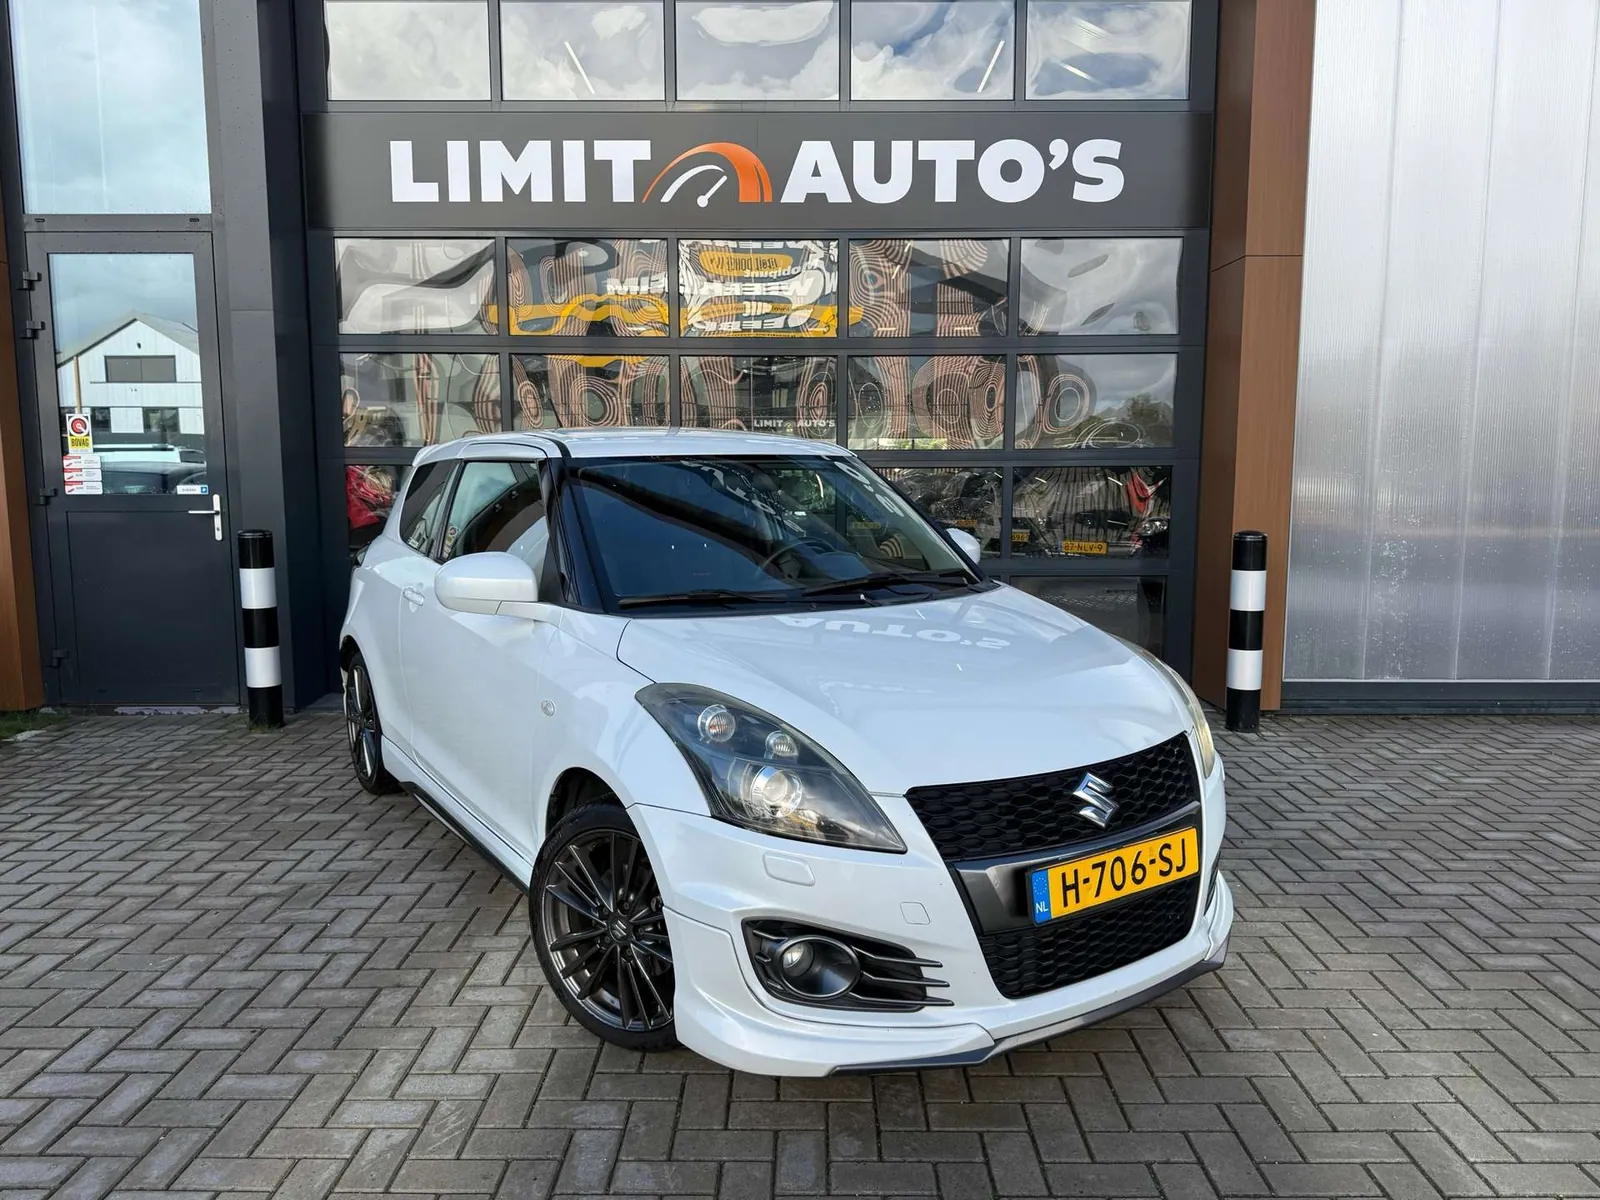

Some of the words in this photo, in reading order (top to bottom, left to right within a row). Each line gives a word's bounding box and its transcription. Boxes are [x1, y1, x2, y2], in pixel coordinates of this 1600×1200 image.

[389, 139, 651, 204] LIMIT
[780, 138, 1125, 204] AUTO'S
[753, 419, 784, 428] LIMIT
[797, 419, 835, 428] AUTO'S
[71, 437, 90, 448] BOVAG
[1061, 838, 1187, 908] H-706-SJ
[1035, 901, 1049, 913] NL
